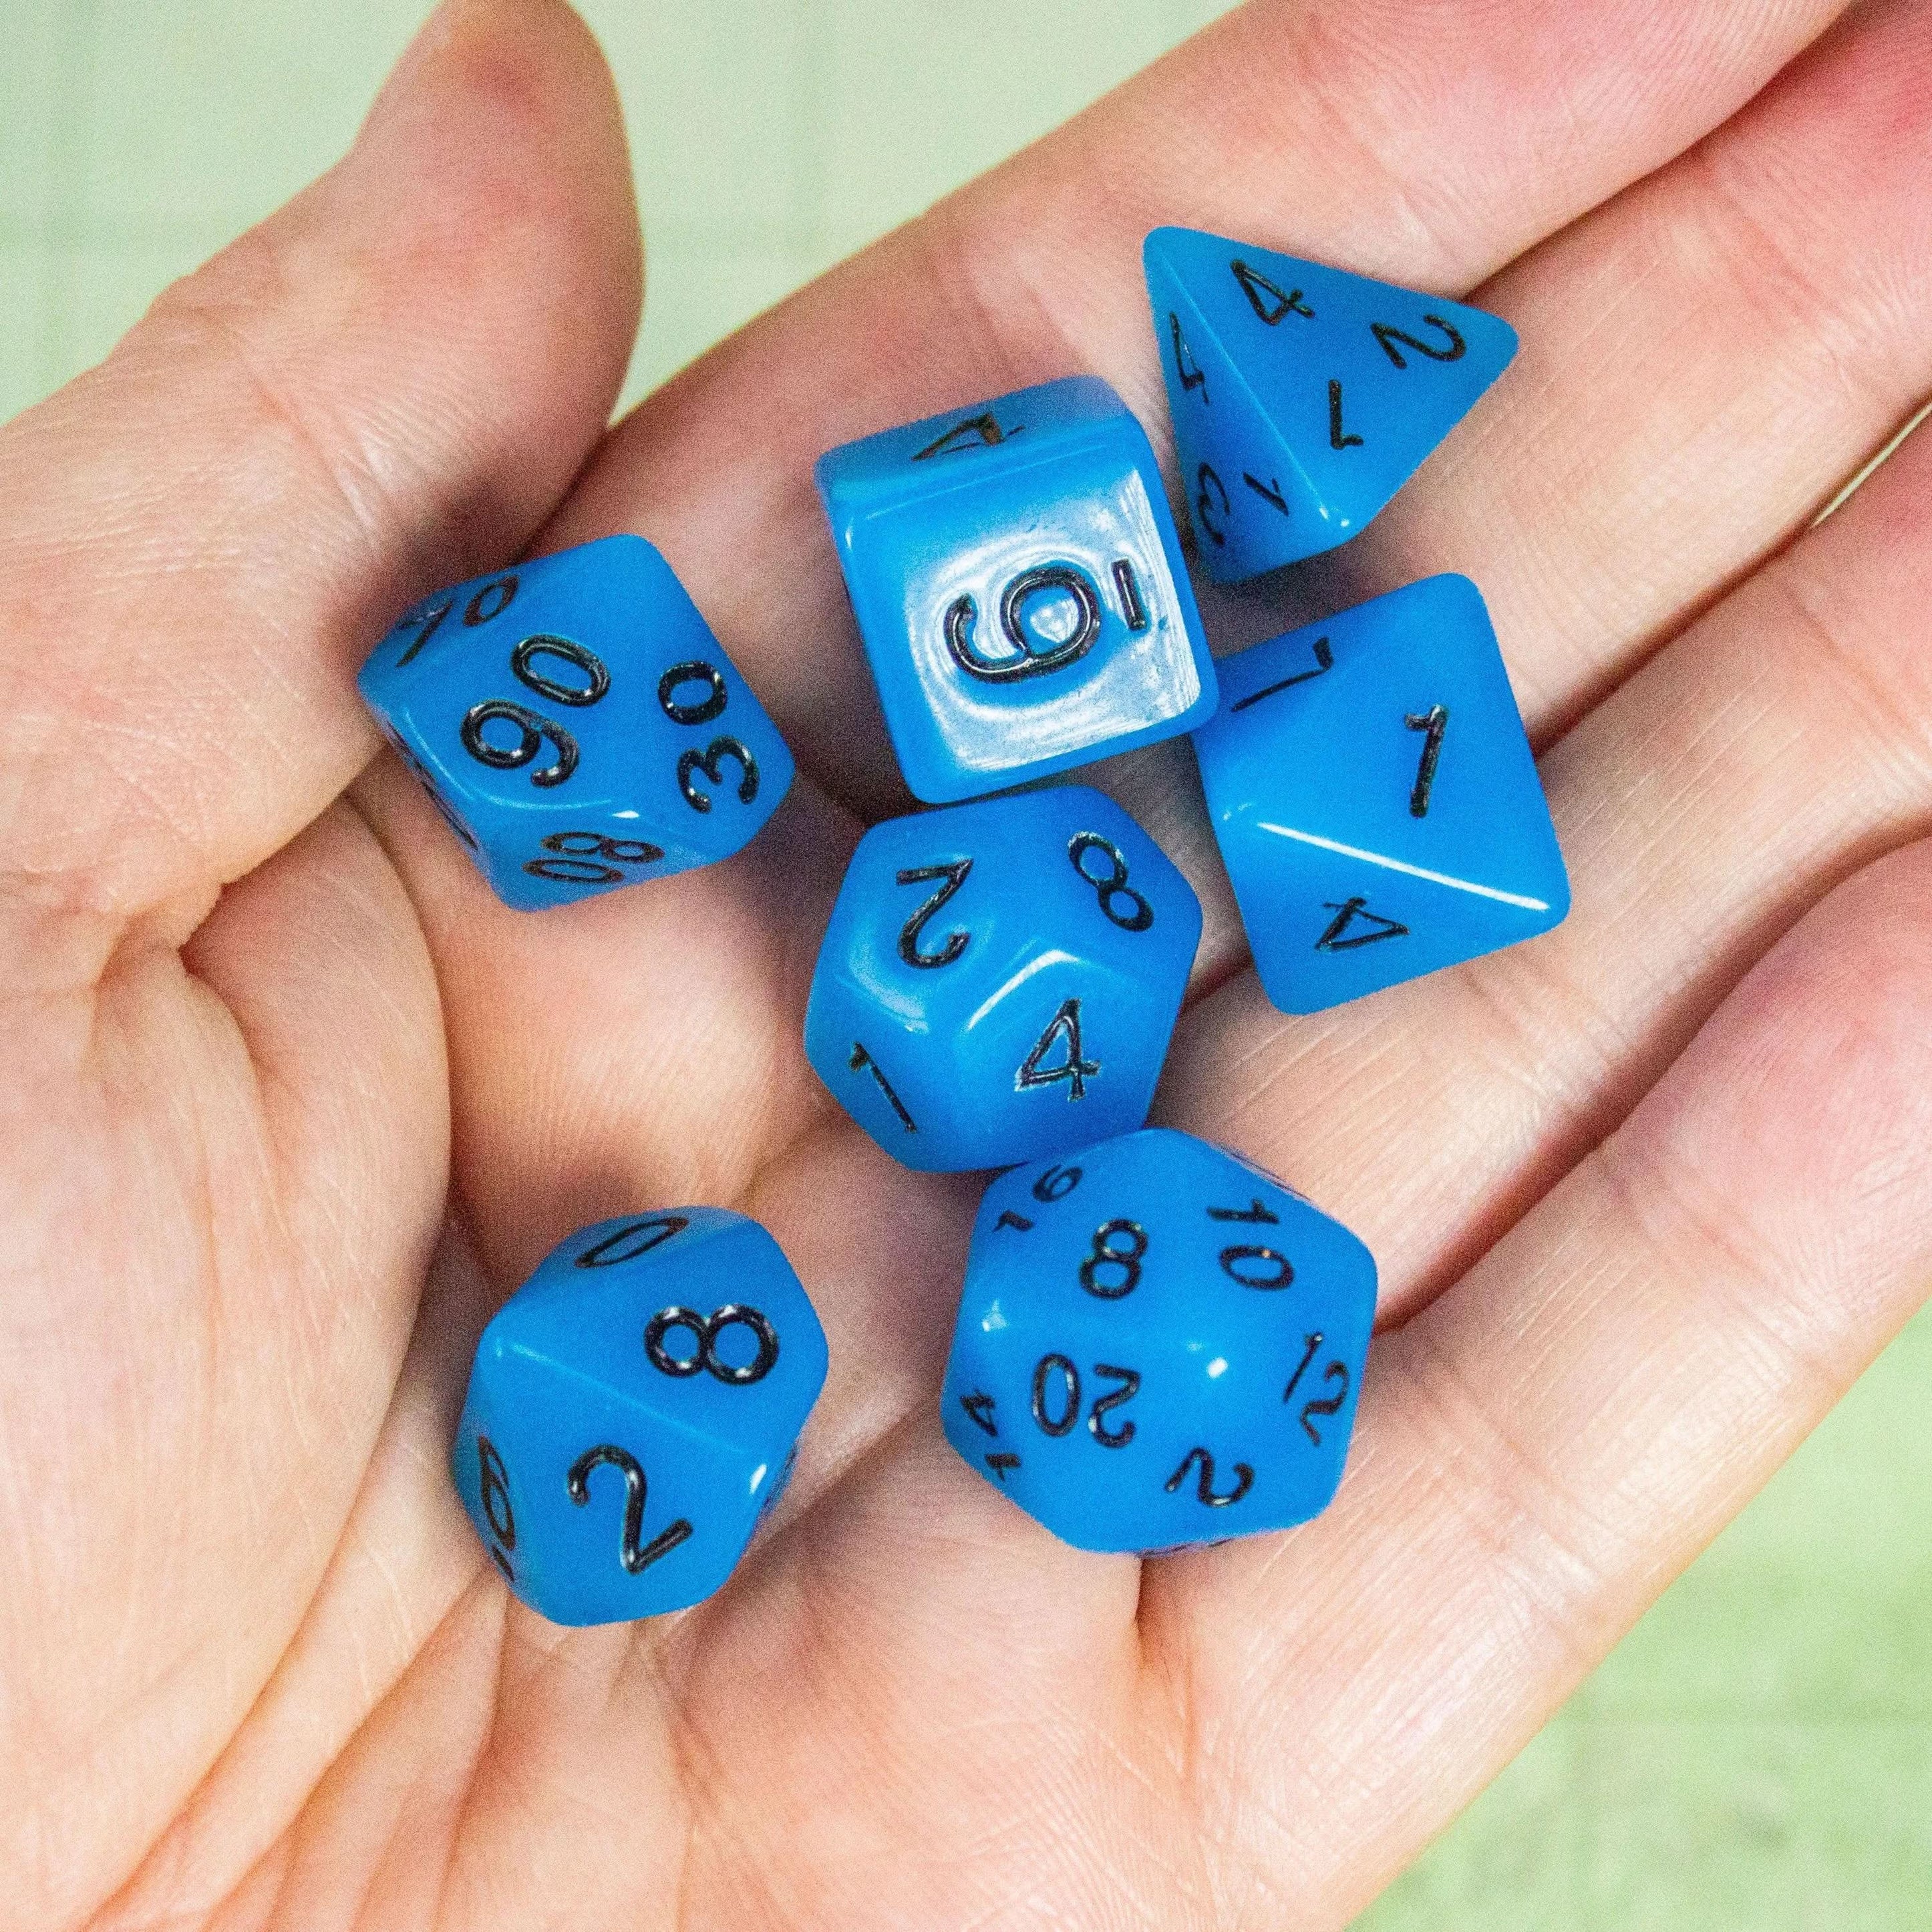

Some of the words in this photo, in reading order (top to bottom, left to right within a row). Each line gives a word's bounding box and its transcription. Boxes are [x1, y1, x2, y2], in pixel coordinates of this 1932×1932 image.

[1230, 259, 1315, 326] 4
[1170, 312, 1209, 404] 4
[1371, 313, 1466, 369] 2
[1328, 379, 1363, 450] 1
[1197, 463, 1230, 544] 3
[1244, 472, 1289, 516] 1
[460, 633, 611, 788] 90
[658, 660, 760, 813] 30
[1405, 703, 1449, 818] 1
[523, 832, 665, 883] 80
[1069, 831, 1154, 931] 8
[896, 858, 973, 969] 2
[1315, 897, 1409, 951] 4
[848, 1041, 917, 1134] 1
[1015, 998, 1100, 1101] 4
[575, 1219, 688, 1267] 0
[1079, 1219, 1148, 1299] 8
[1207, 1198, 1294, 1291] 10
[643, 1303, 779, 1385] 8
[1285, 1333, 1349, 1446] 12
[1032, 1353, 1140, 1448] 20
[567, 1444, 693, 1575] 2
[1164, 1447, 1254, 1507] 2
